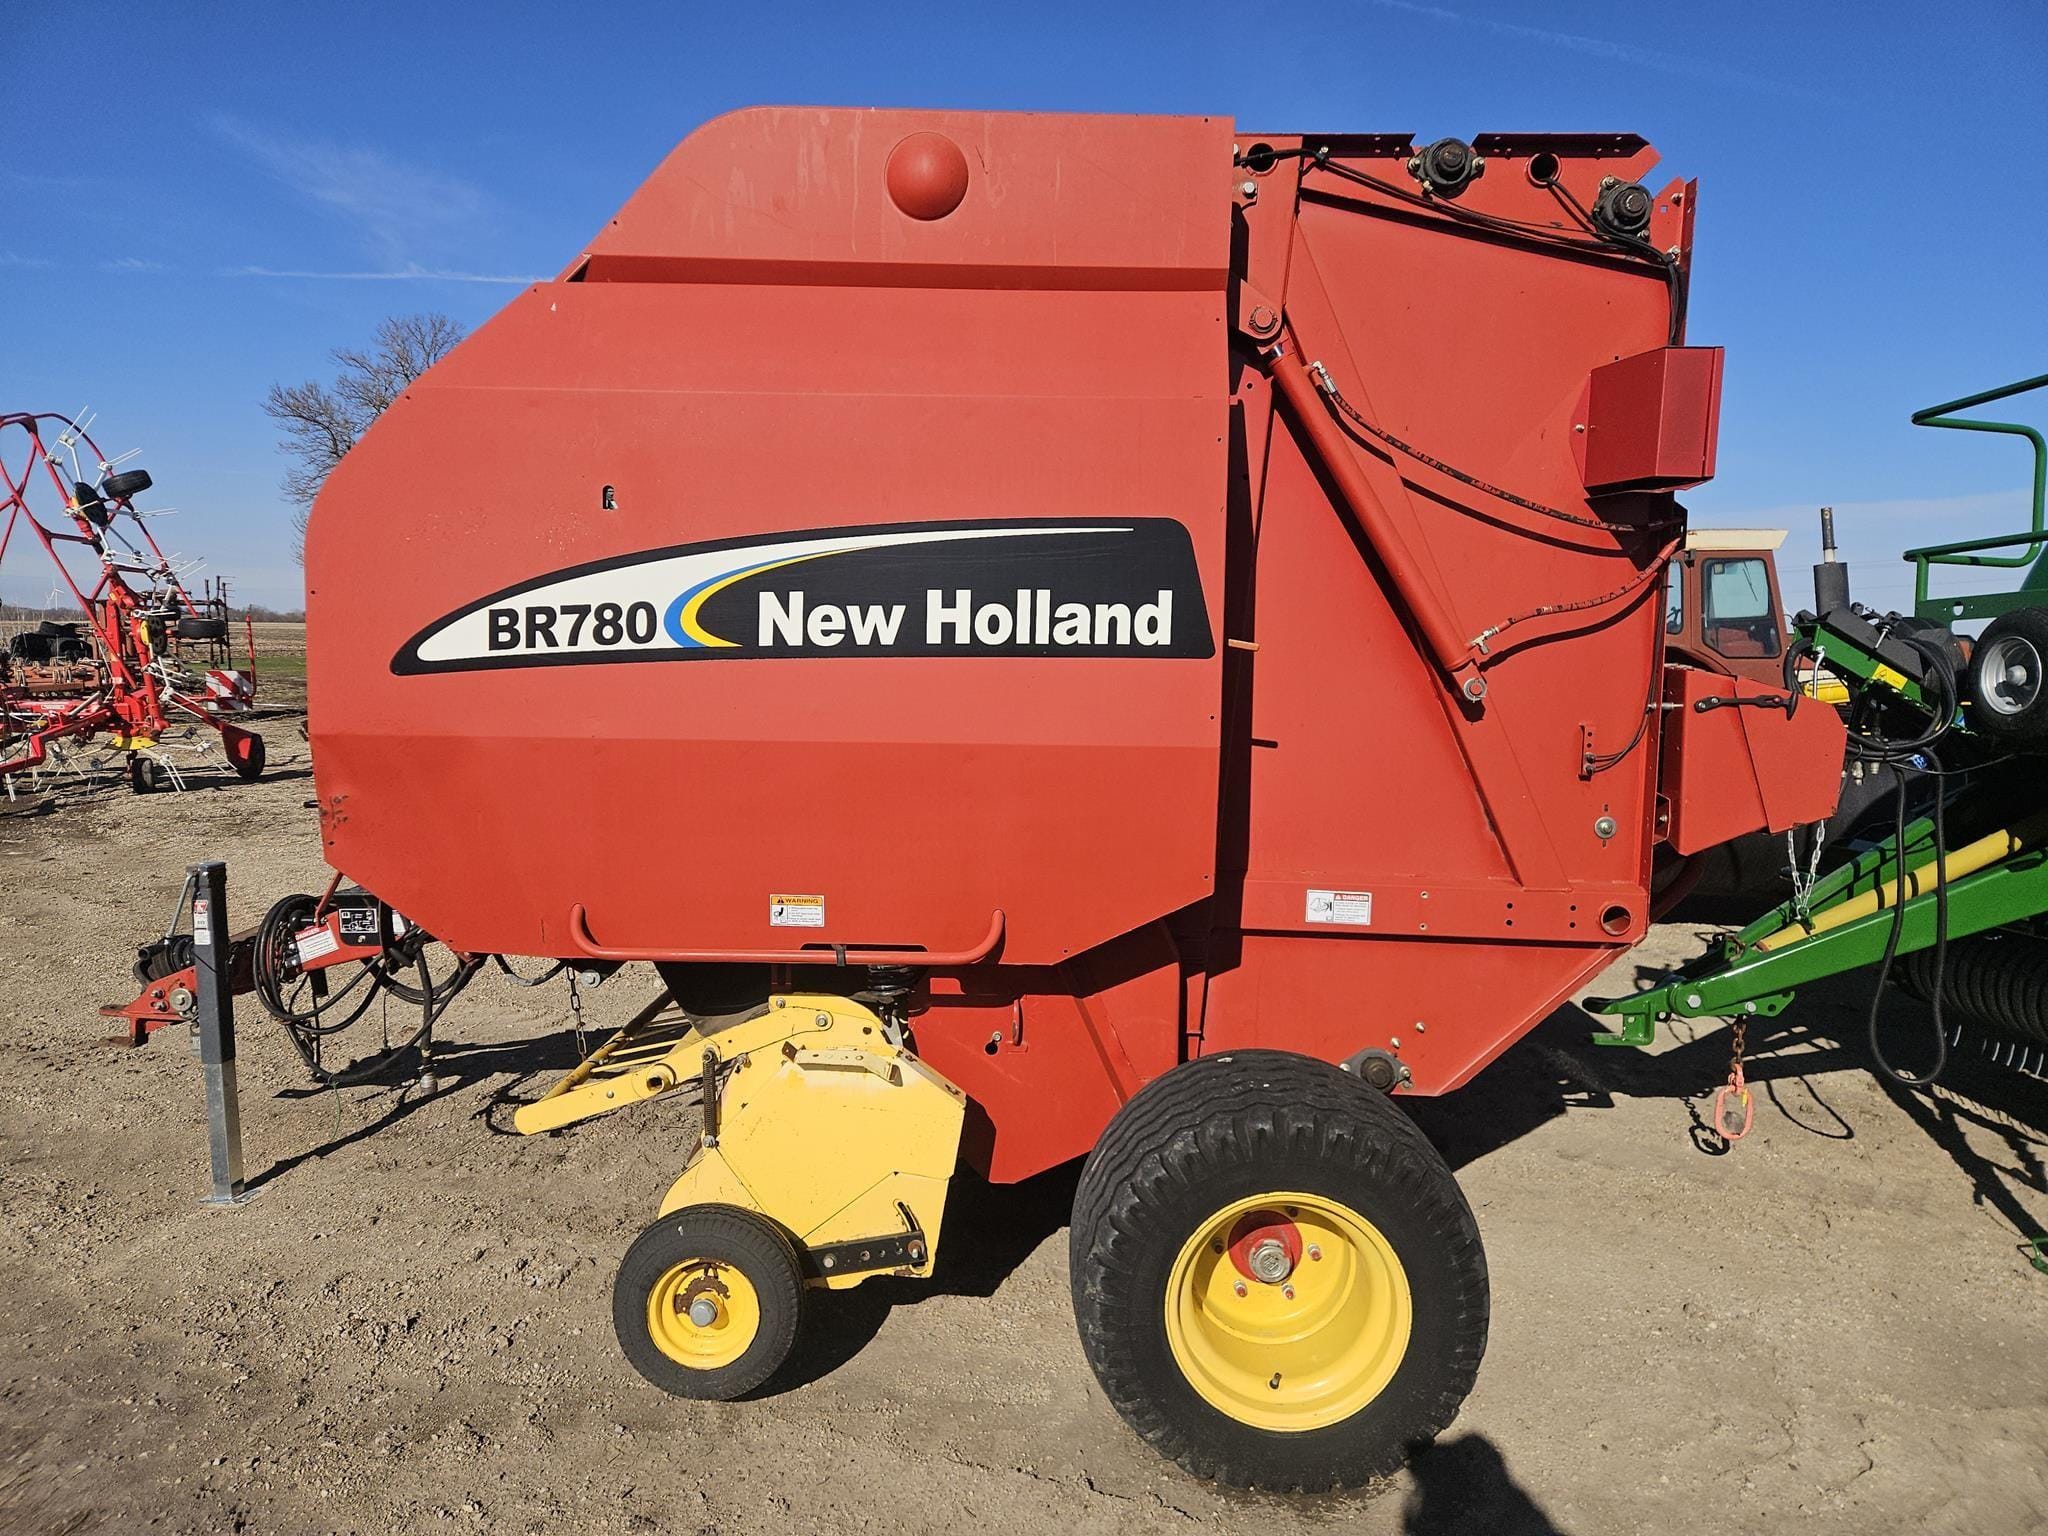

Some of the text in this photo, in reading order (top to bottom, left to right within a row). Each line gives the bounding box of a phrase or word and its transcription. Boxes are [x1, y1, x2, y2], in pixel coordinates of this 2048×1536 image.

[488, 587, 1174, 651] BR780 New Holland
